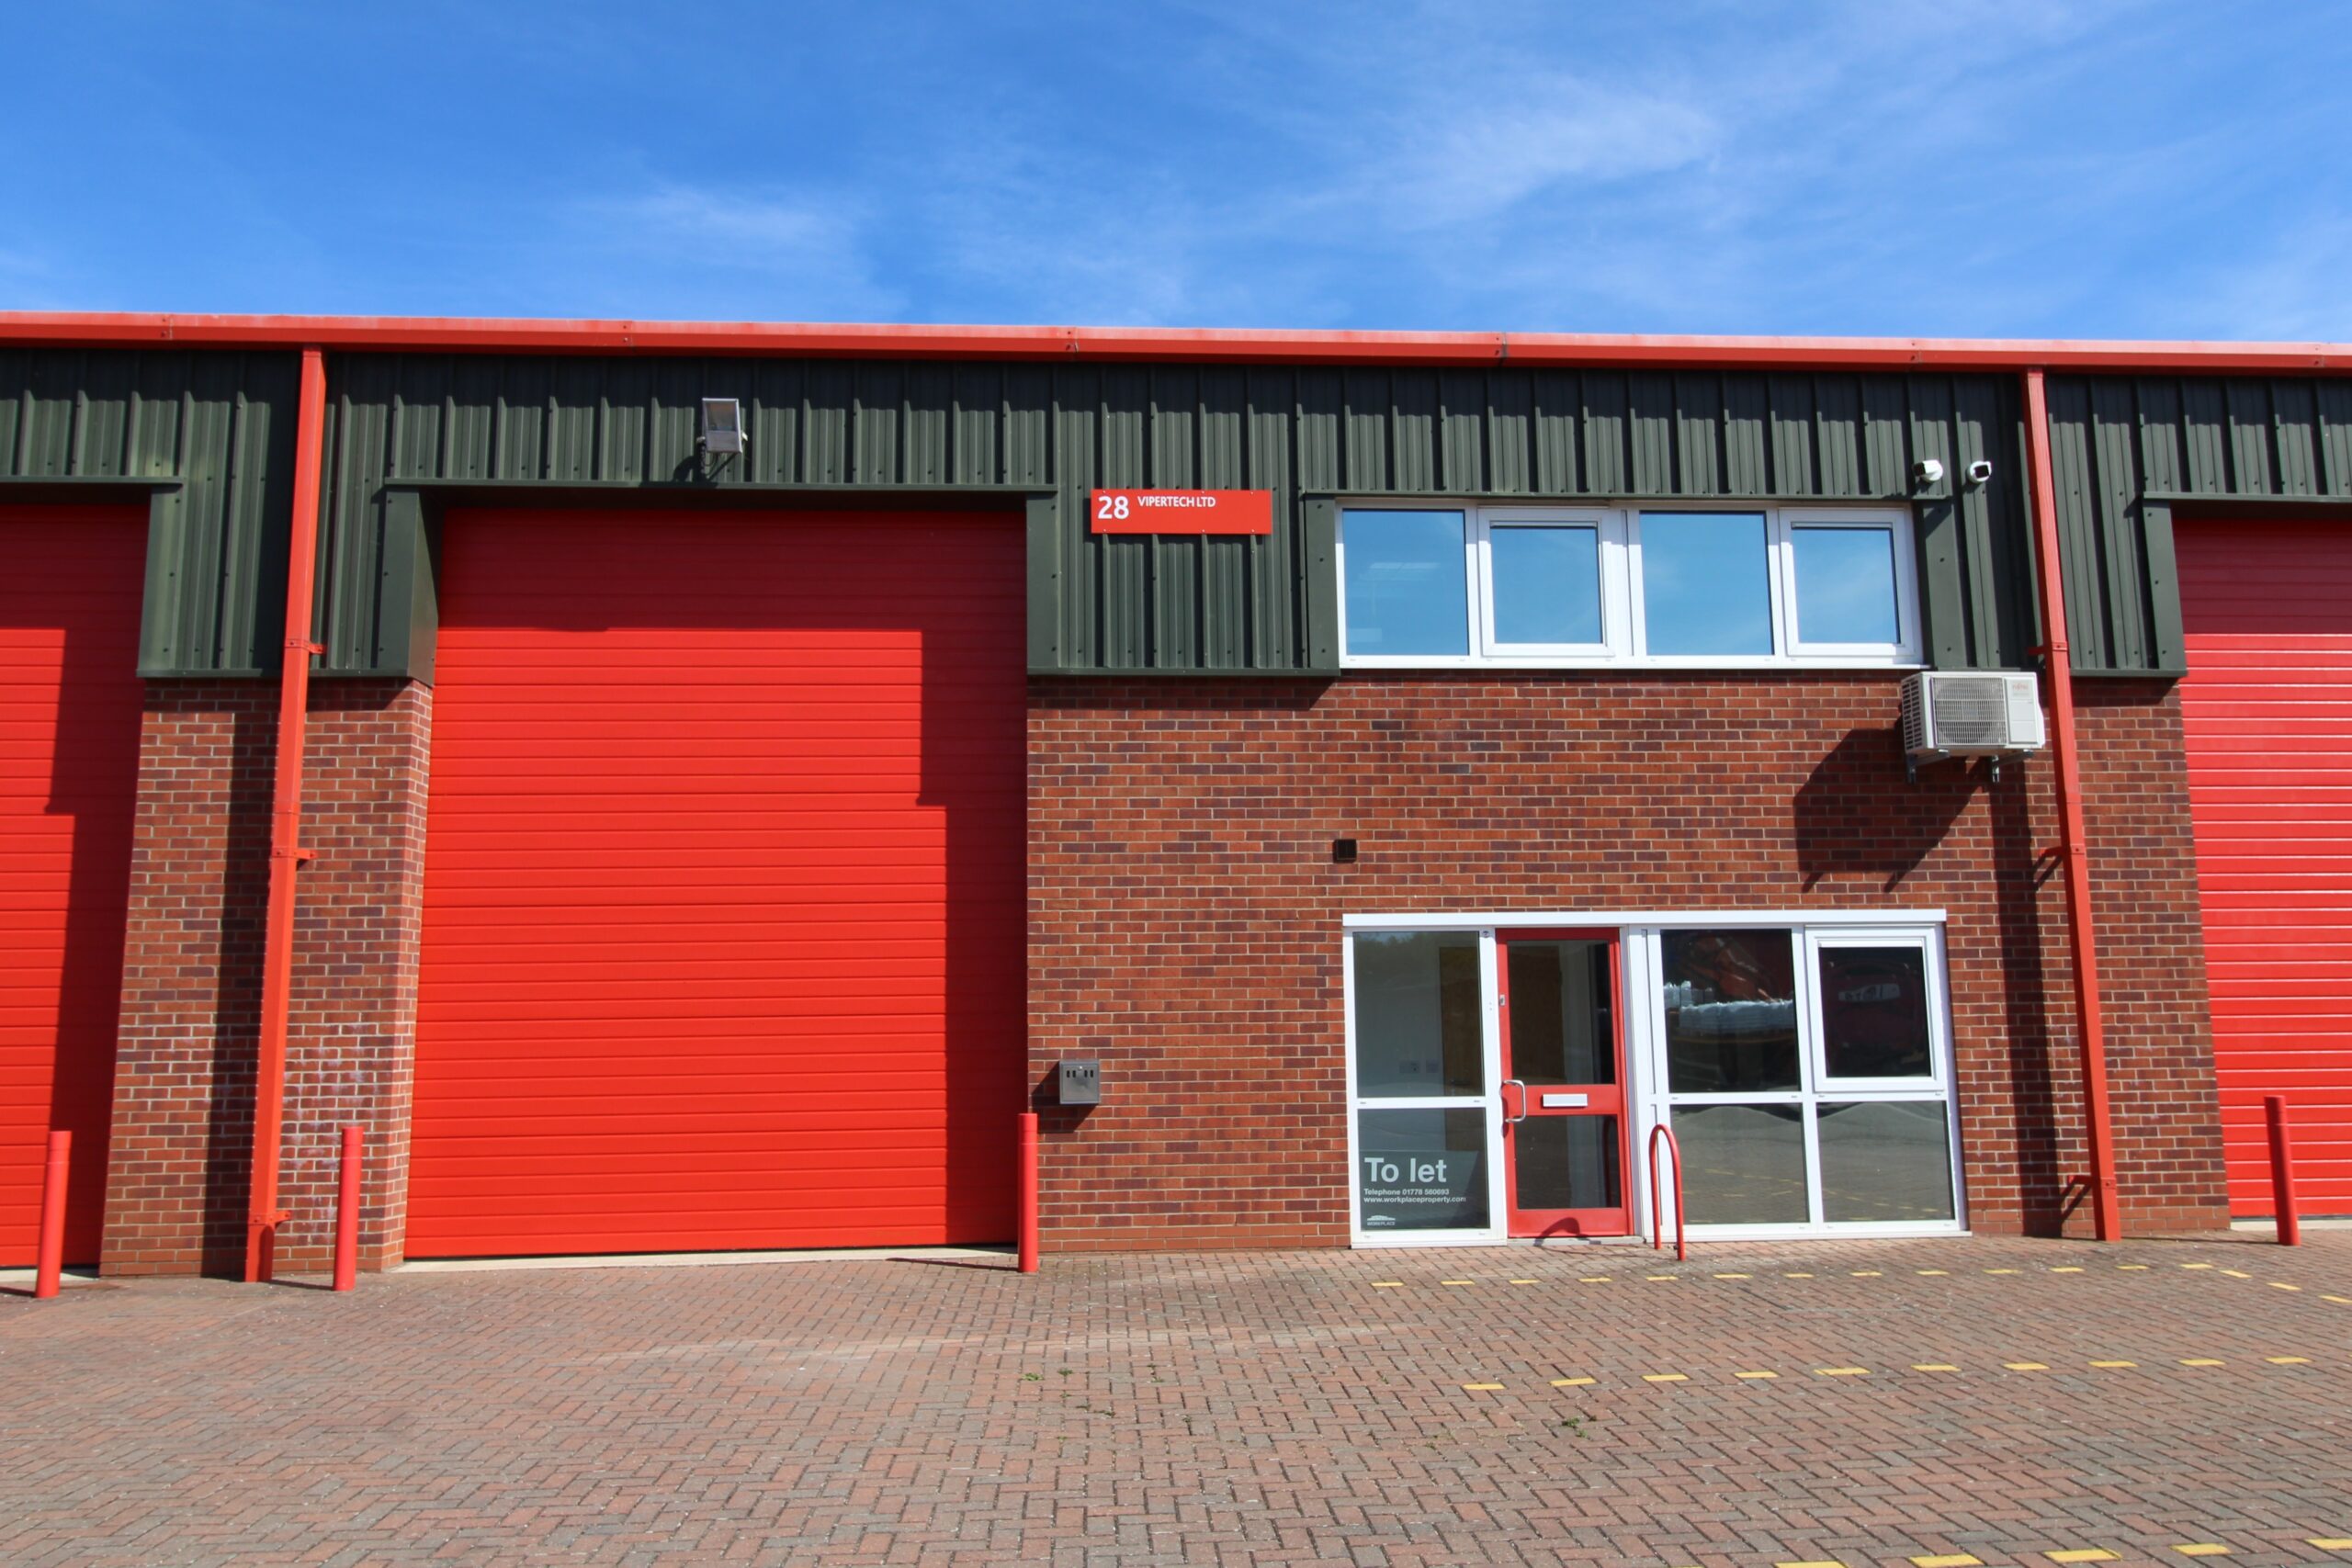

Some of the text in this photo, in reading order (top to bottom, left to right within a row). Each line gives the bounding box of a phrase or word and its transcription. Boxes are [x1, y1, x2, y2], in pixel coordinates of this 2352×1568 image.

[1097, 495, 1216, 520] 28 VIPERTECH LTD
[1364, 1157, 1447, 1183] To let
[1363, 1188, 1401, 1197] Telephone
[1363, 1196, 1466, 1204] www.workplaceproperty.com
